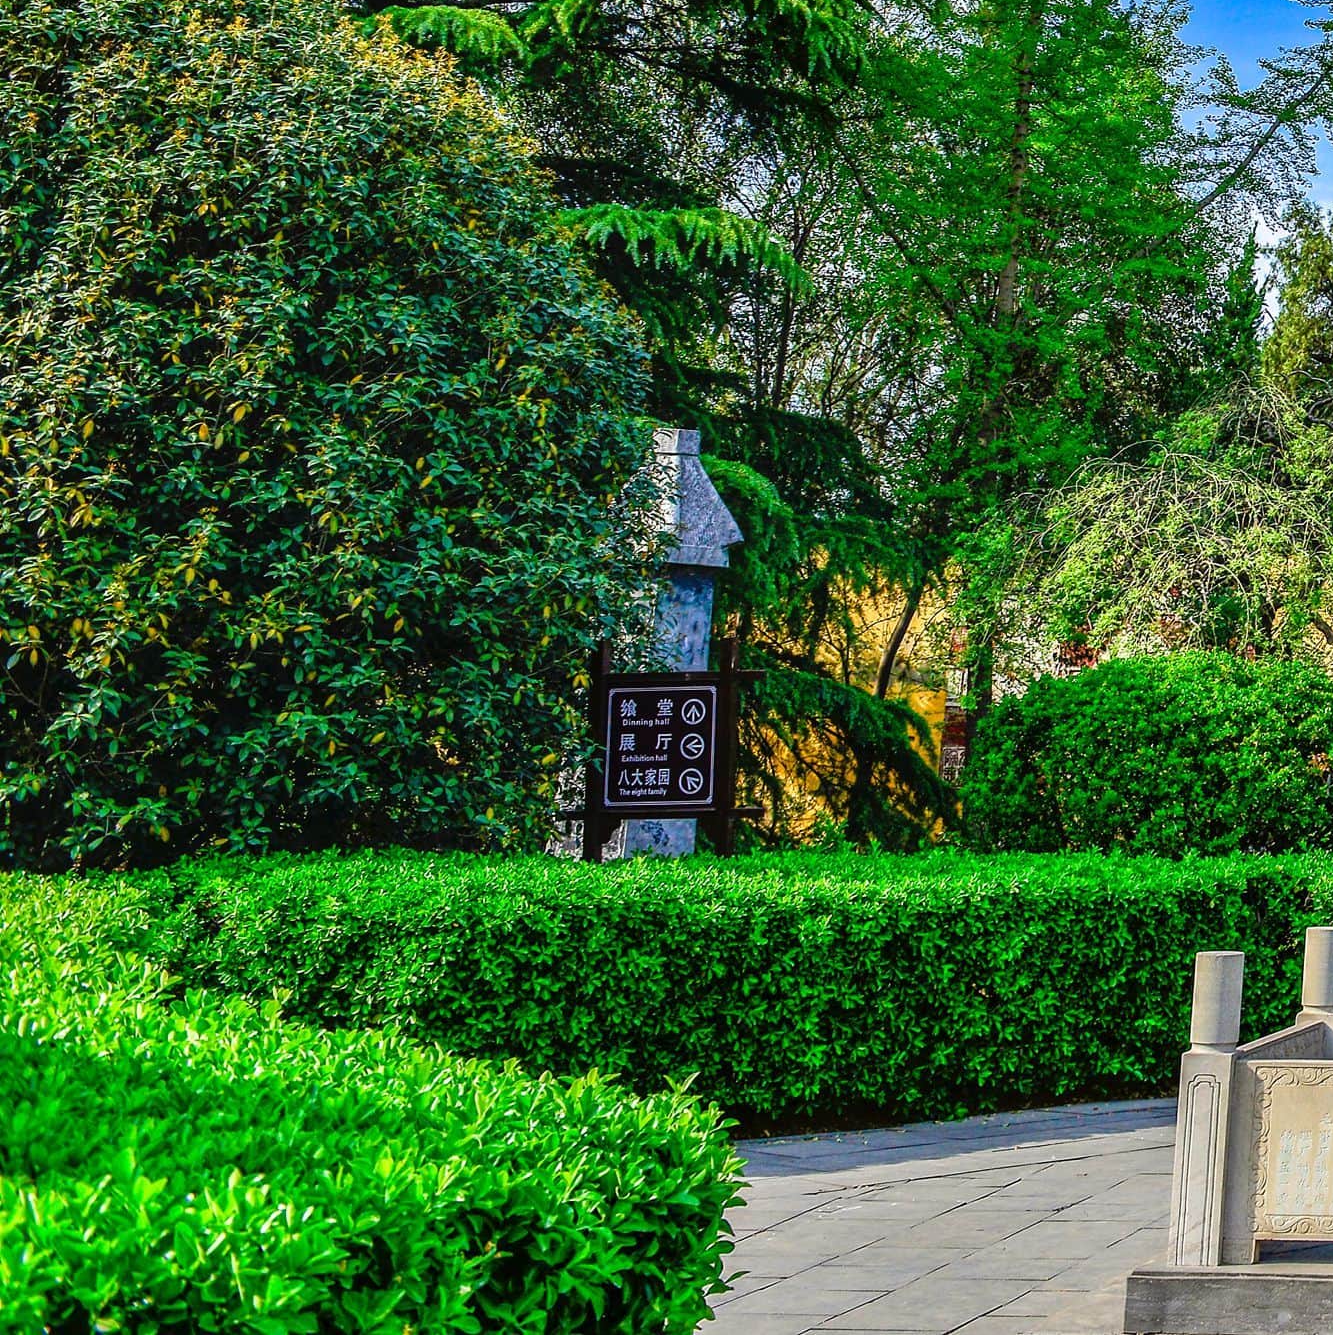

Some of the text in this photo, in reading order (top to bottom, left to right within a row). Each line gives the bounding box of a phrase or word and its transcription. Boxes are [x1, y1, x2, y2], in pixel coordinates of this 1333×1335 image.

[655, 718, 670, 726] hall
[618, 733, 672, 751] 展厅
[655, 754, 668, 762] hall
[617, 768, 670, 785] 八大家园
